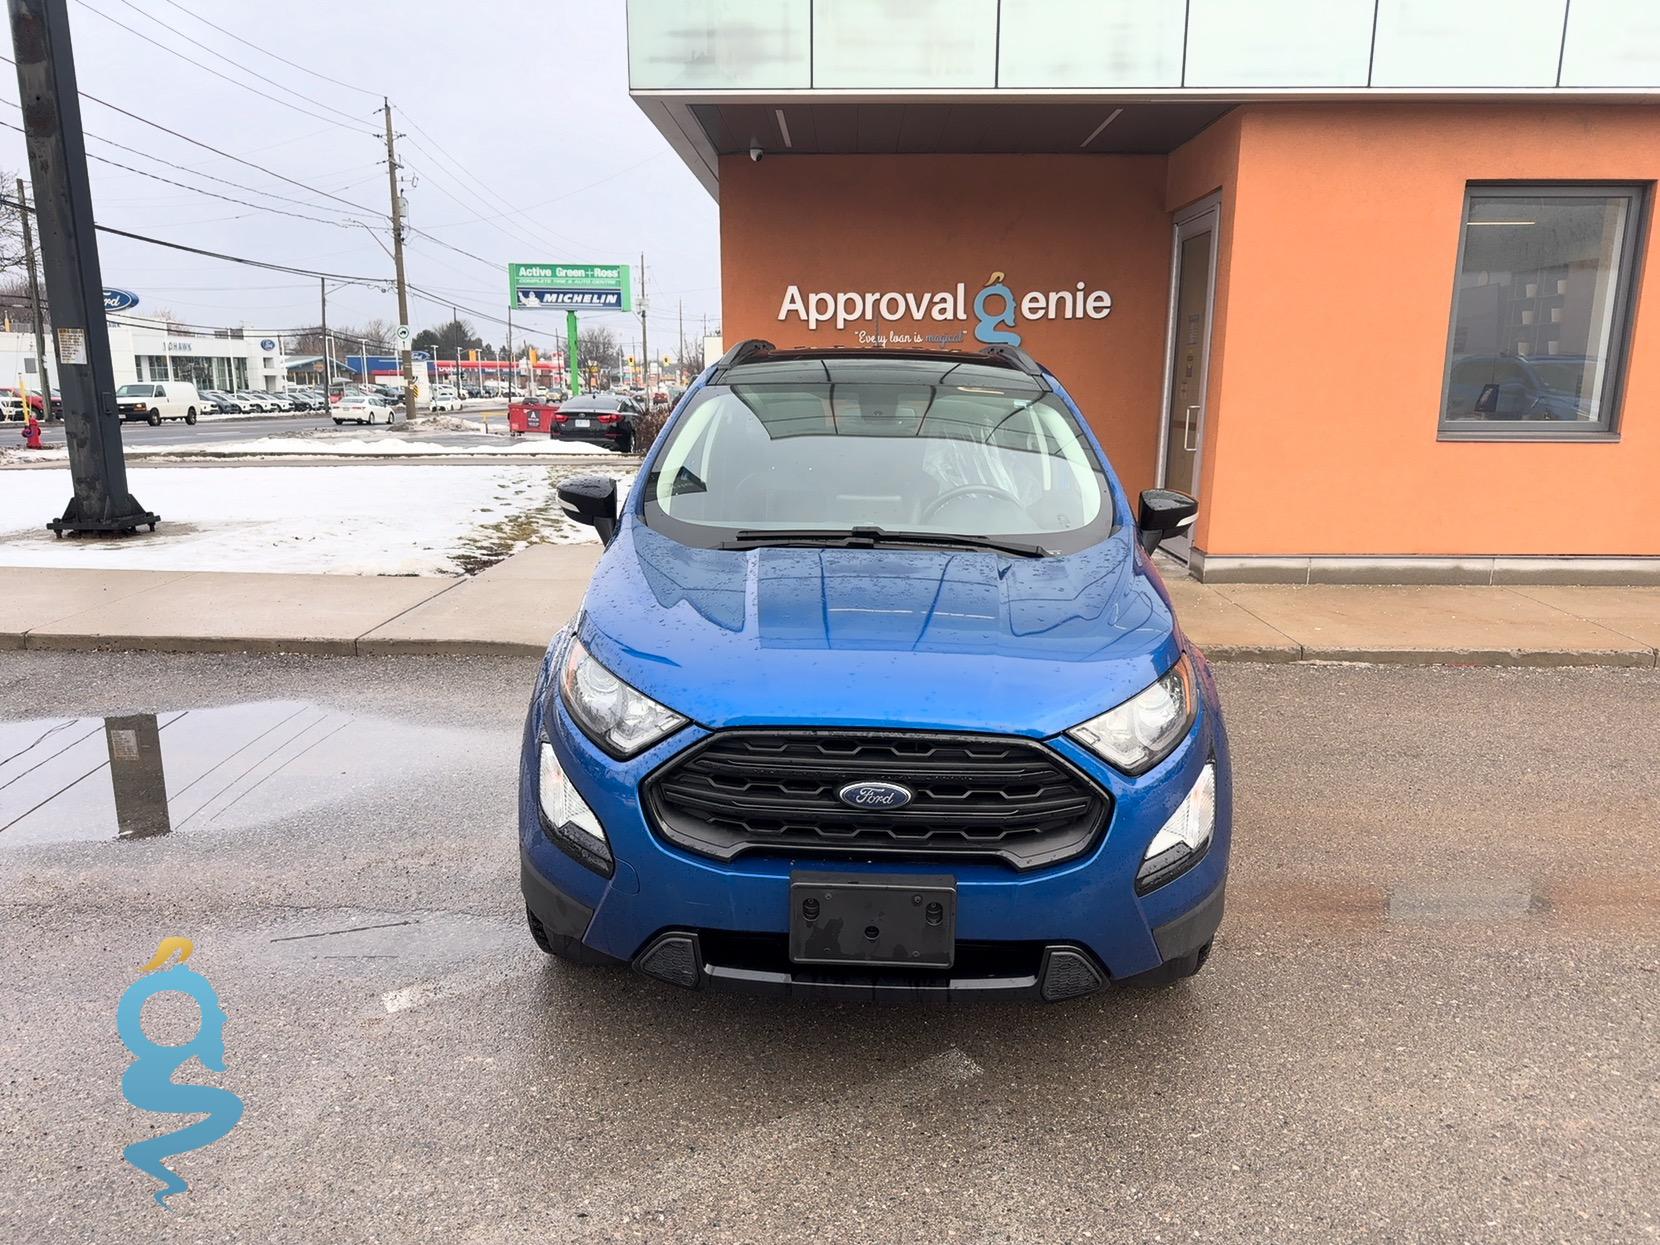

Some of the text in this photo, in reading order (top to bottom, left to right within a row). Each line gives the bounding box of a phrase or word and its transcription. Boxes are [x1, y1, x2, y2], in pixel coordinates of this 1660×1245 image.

[518, 266, 552, 277] Active
[543, 293, 618, 304] MICHELIN
[777, 282, 967, 330] Approval
[889, 330, 912, 343] loan
[913, 331, 924, 343] is
[855, 786, 895, 805] Ford
